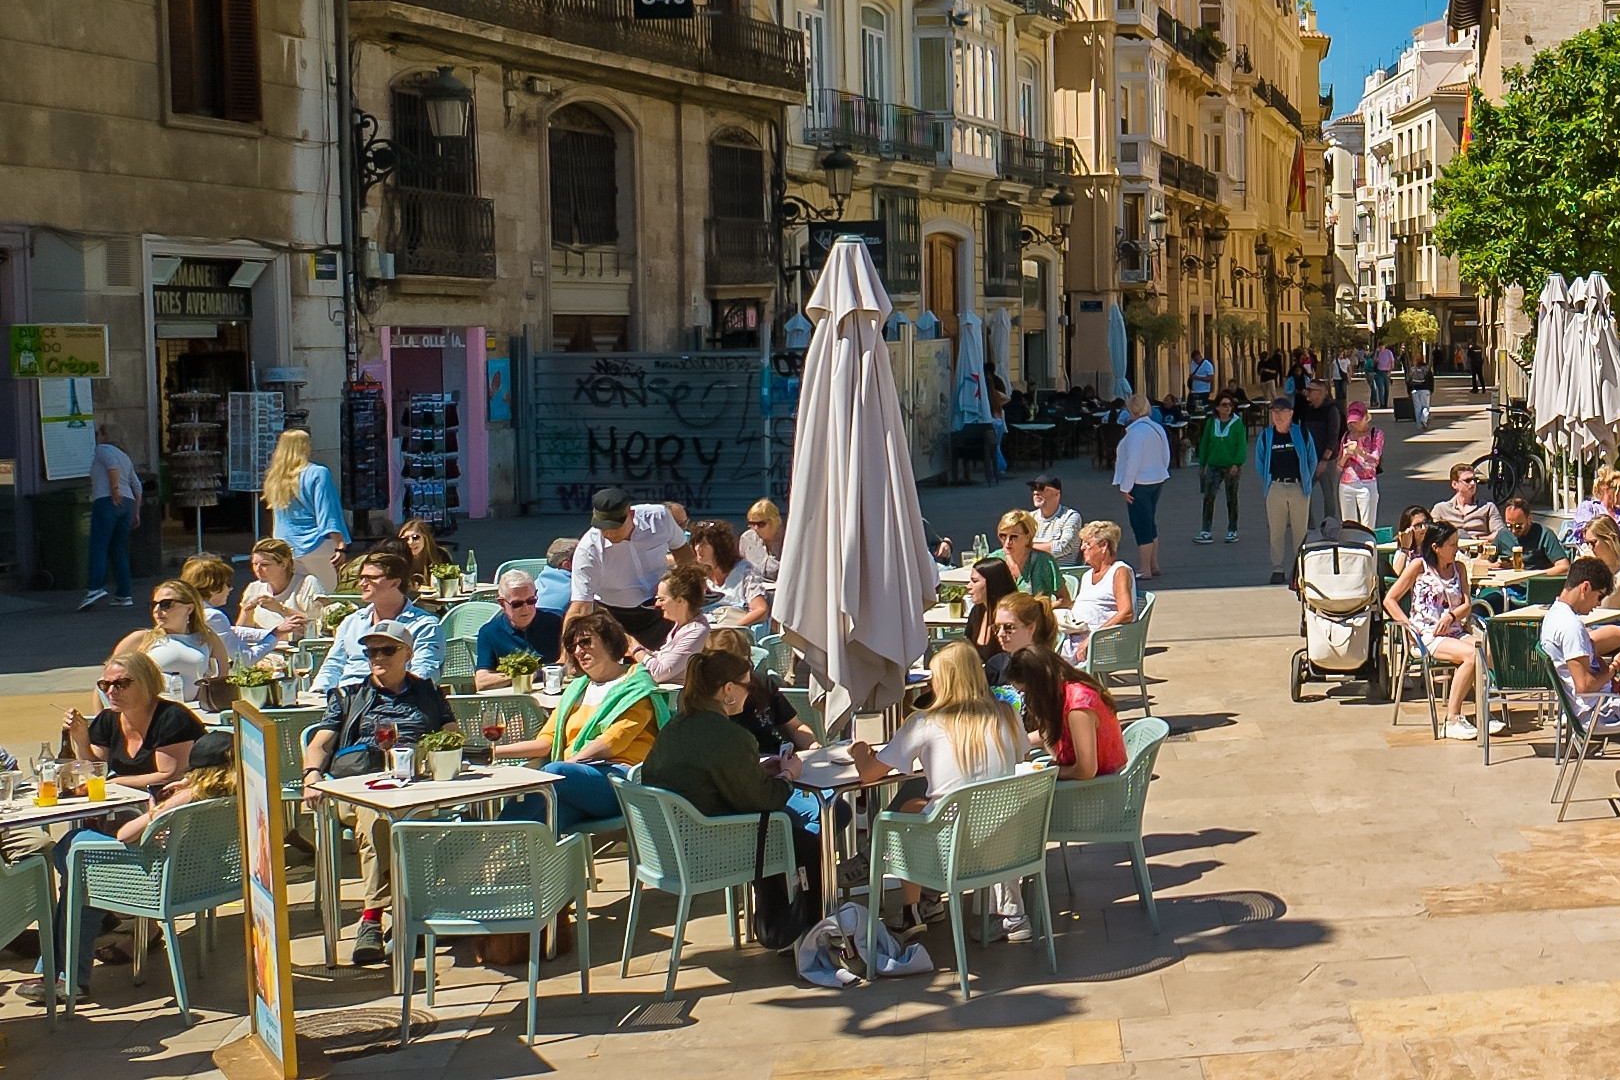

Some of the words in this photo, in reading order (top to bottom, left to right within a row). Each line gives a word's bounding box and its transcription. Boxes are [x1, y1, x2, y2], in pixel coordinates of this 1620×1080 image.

[154, 290, 182, 314] TRES
[185, 291, 246, 315] AVEMARIAS
[19, 327, 57, 339] DULCE
[15, 342, 62, 354] SALADO
[401, 335, 416, 348] LA
[46, 354, 100, 376] Crêpe
